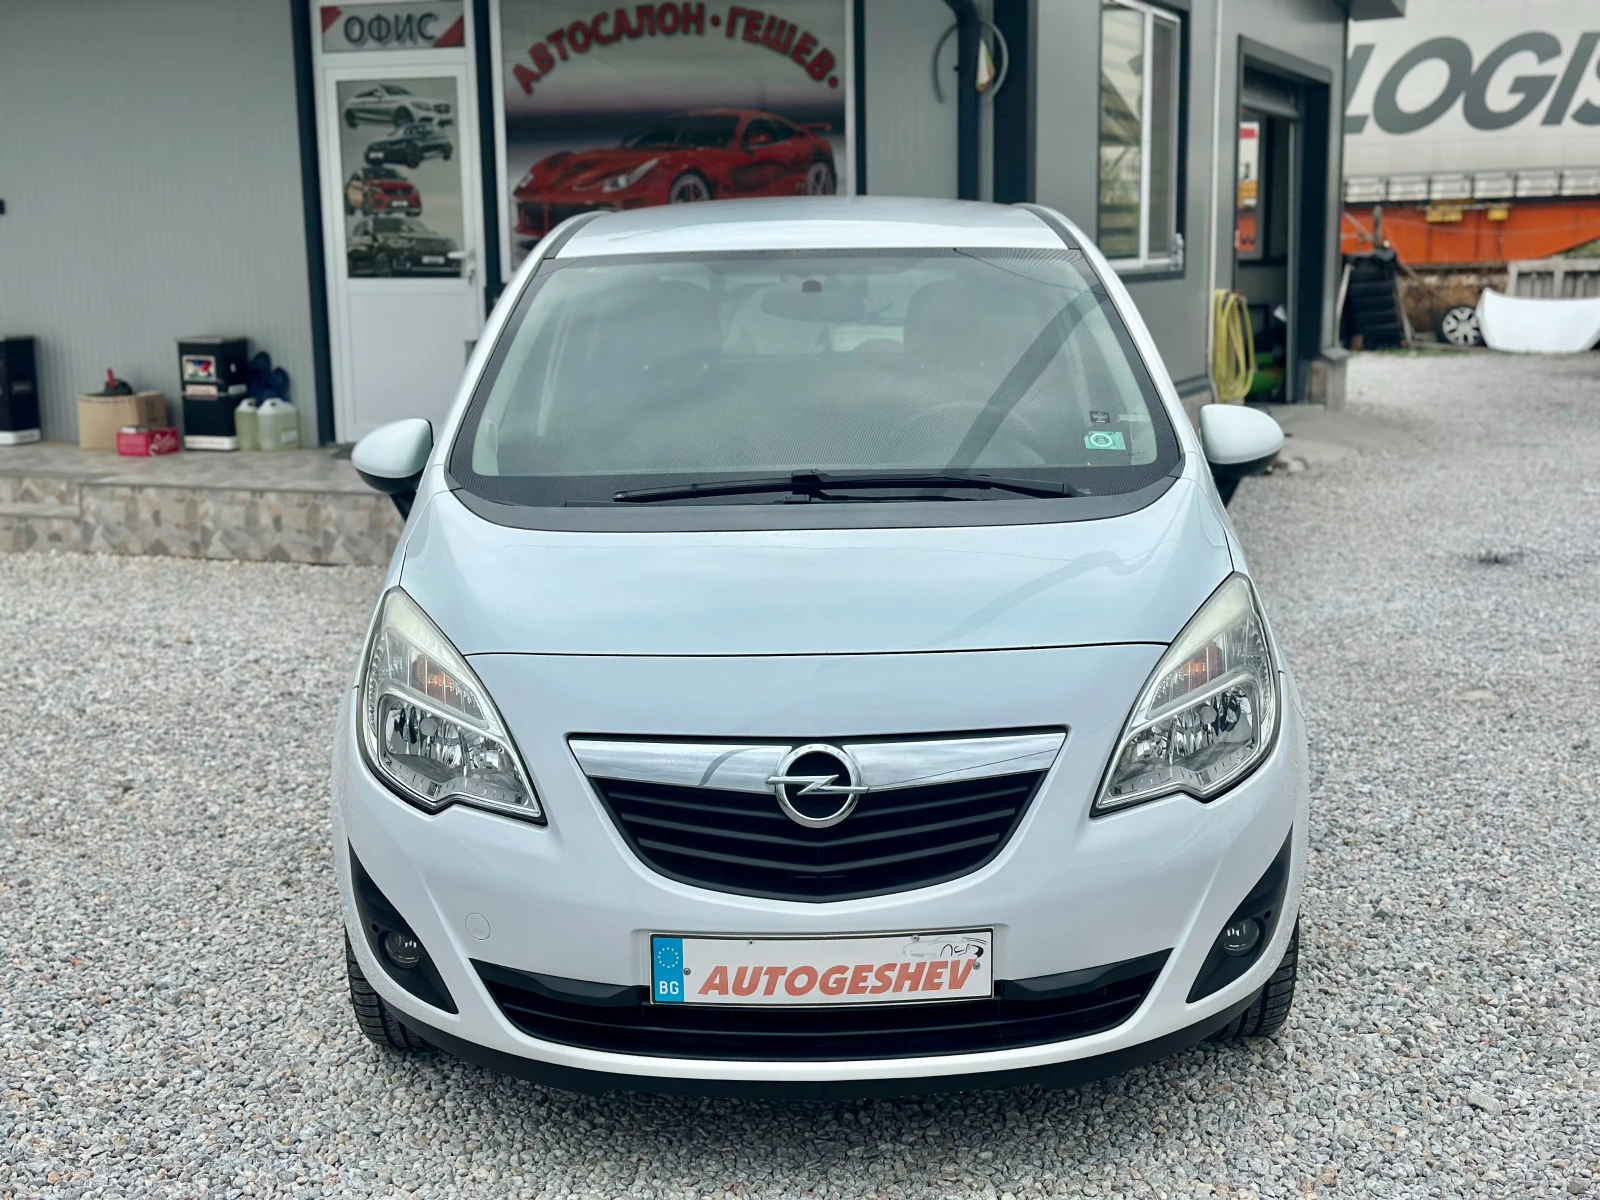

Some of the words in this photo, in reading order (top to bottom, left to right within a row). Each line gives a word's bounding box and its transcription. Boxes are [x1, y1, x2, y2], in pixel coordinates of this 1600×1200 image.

[344, 12, 438, 46] ОФИС
[512, 2, 705, 96] АВТОСАЛОН
[726, 6, 835, 82] ГЕШЕВ
[659, 980, 680, 995] BG
[697, 958, 975, 997] AUTOGESHEV
